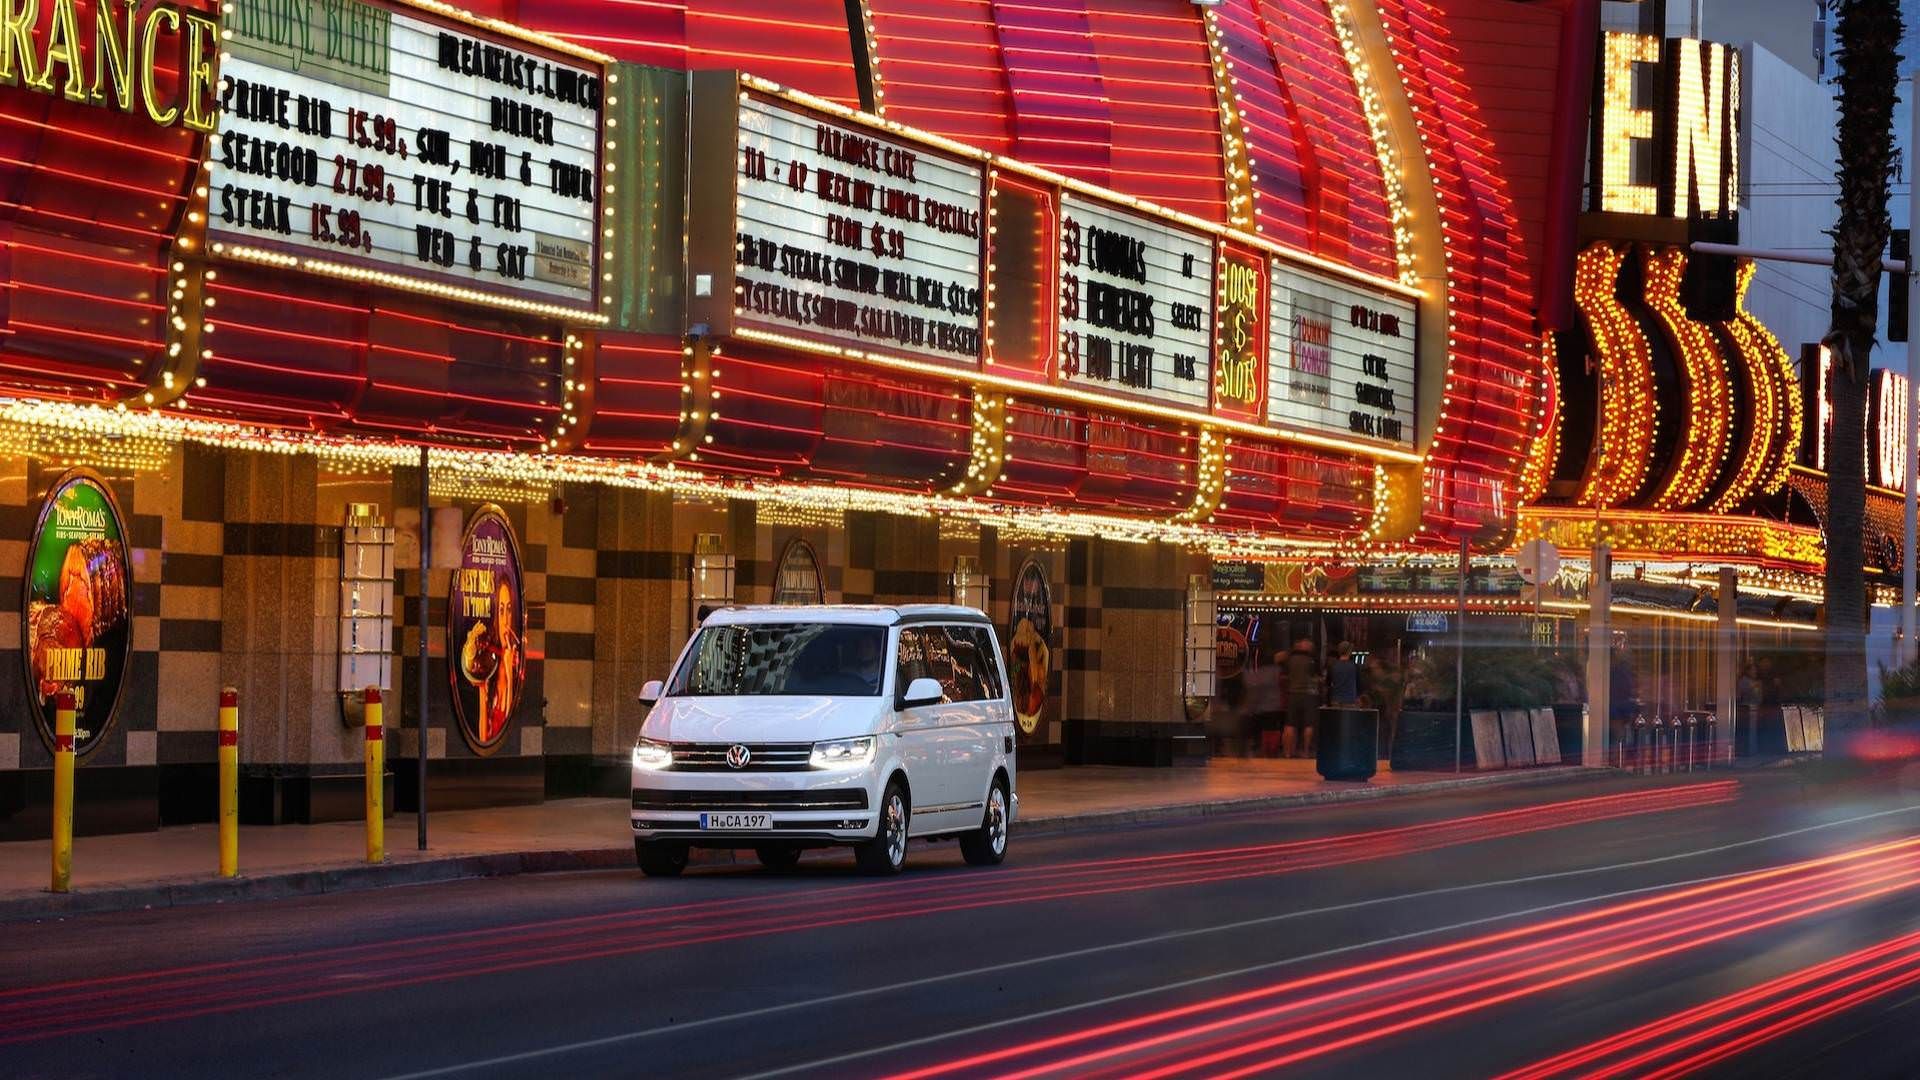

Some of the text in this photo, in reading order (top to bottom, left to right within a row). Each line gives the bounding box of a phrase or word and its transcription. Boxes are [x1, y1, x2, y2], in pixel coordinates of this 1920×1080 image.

[222, 74, 290, 130] PRIME
[298, 94, 332, 139] RIB
[490, 95, 554, 147] DINNER
[221, 129, 318, 187] SEAFOOD
[470, 139, 506, 181] MON
[817, 124, 917, 184] PARADISE CAFE
[221, 183, 291, 235] STEAK
[413, 174, 452, 219] TUE
[494, 193, 521, 233] FRI
[880, 185, 919, 223] LUNCH
[924, 198, 979, 239] SPECIALS
[416, 224, 455, 268] WED
[497, 242, 528, 281] SAT
[827, 213, 862, 251] FROM
[781, 244, 822, 284] STEAK
[1222, 259, 1258, 322] LOOSE
[1221, 348, 1258, 402] SLOTS
[45, 647, 106, 680] PRIME RIB
